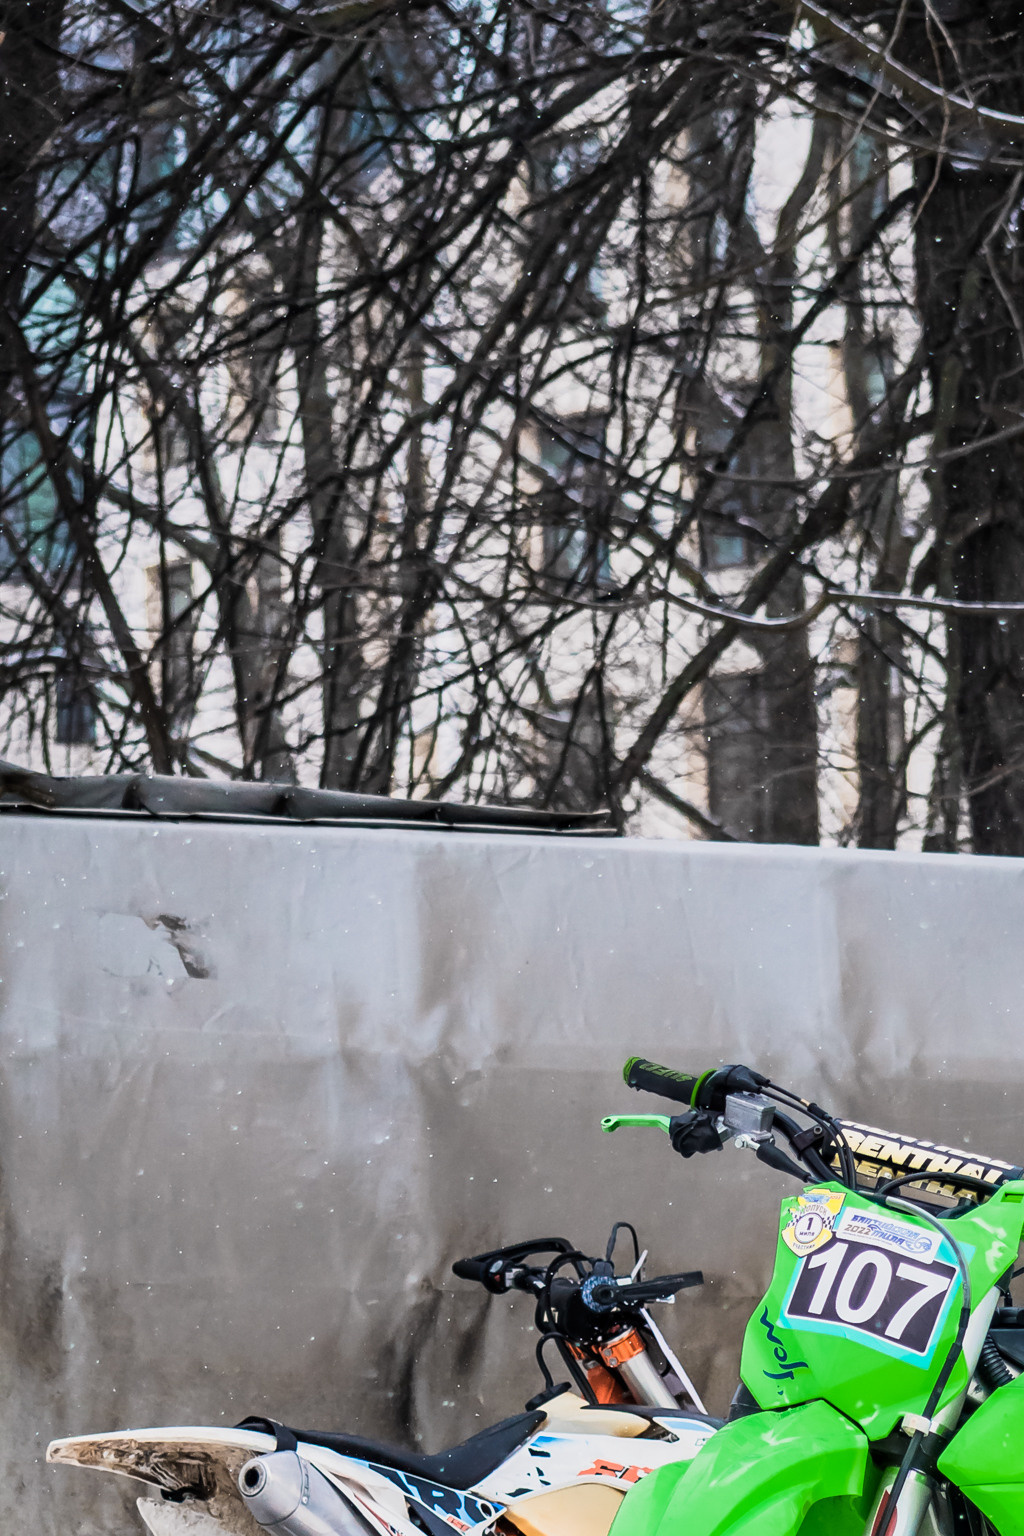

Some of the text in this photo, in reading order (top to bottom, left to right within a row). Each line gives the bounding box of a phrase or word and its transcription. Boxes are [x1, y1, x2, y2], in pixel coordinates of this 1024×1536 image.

[806, 1217, 814, 1231] 1
[844, 1223, 872, 1236] 2022
[807, 1241, 952, 1339] 107
